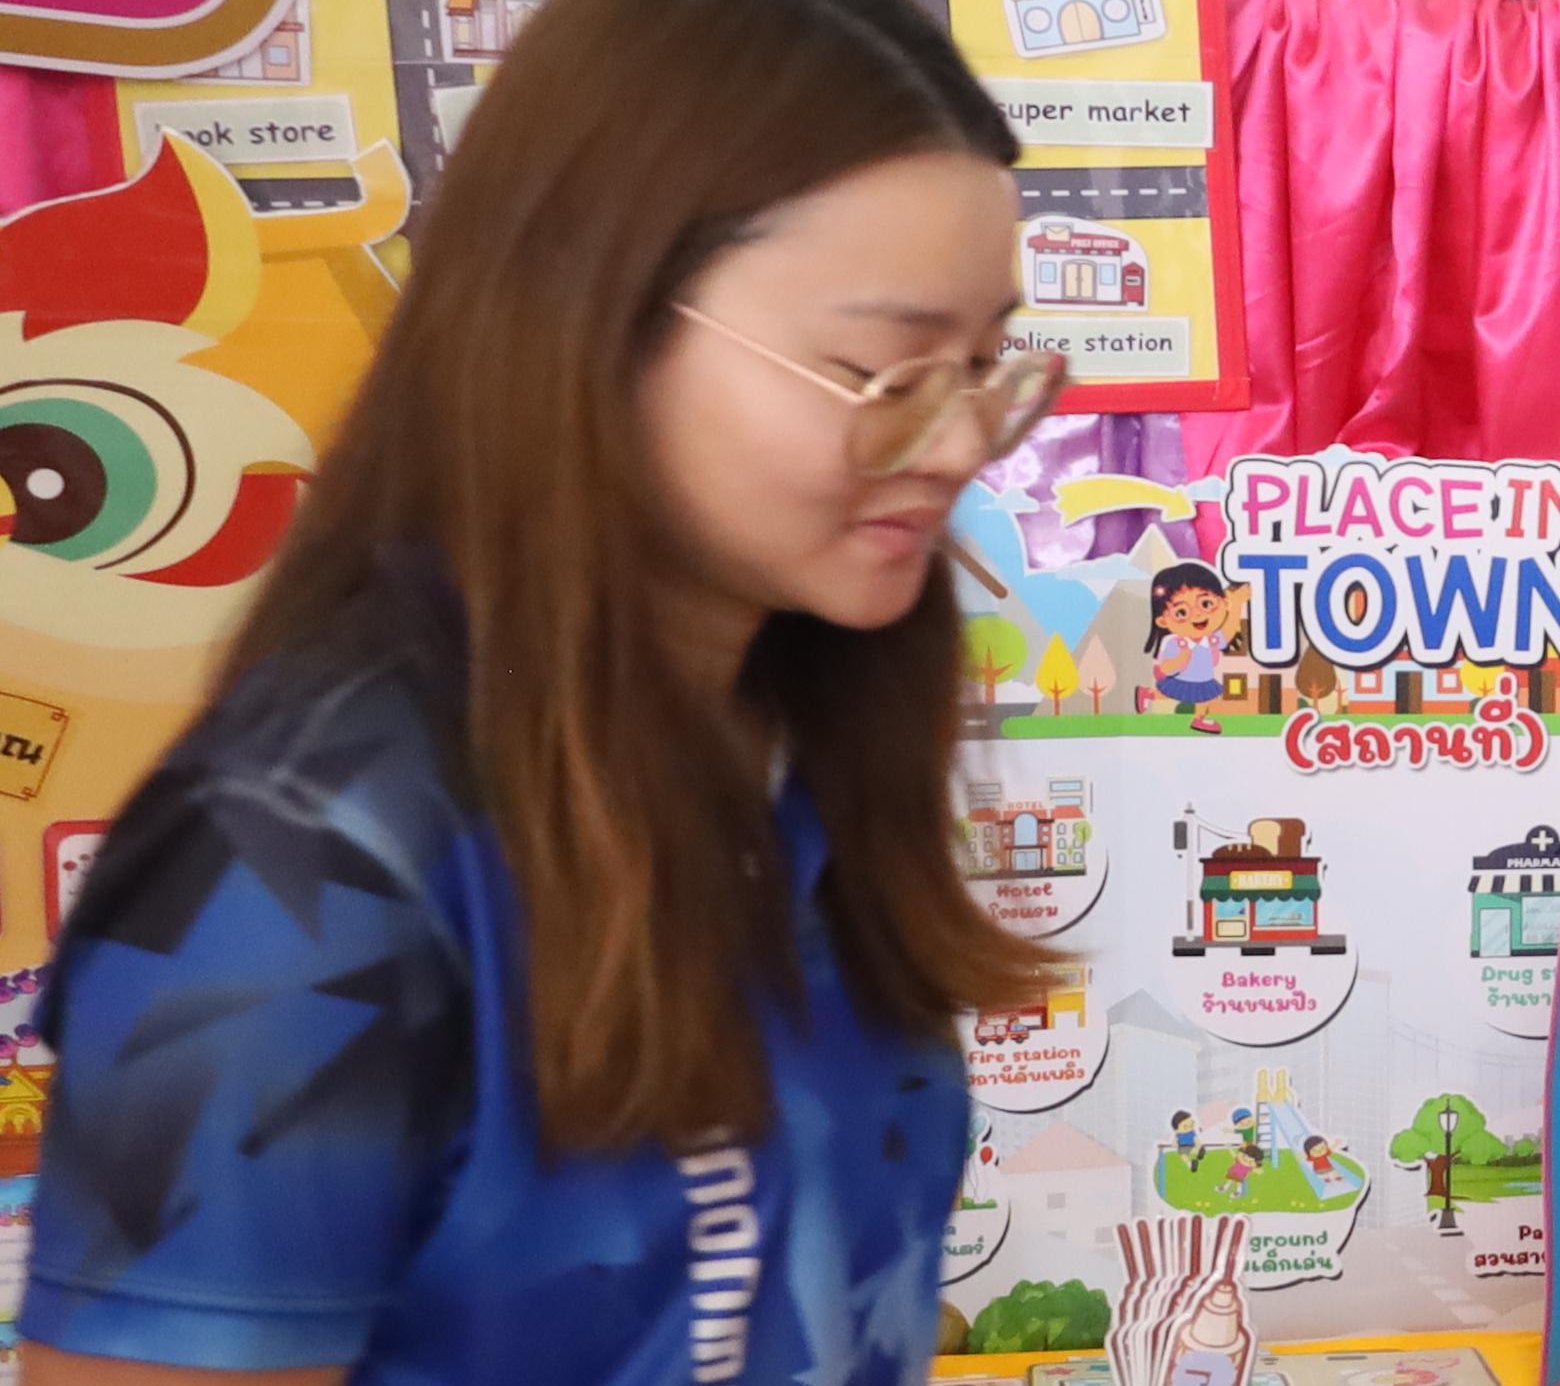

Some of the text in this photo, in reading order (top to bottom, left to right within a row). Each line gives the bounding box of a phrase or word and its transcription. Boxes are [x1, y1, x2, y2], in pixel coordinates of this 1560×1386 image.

[1088, 101, 1192, 124] market
[156, 120, 336, 146] ok store
[1084, 331, 1174, 353] station
[1242, 472, 1484, 540] PLACE
[1284, 675, 1546, 769] (สถานที่)
[996, 883, 1054, 899] Hotel
[1236, 874, 1284, 887] BAKERY
[1221, 972, 1297, 990] Bakery
[1480, 966, 1534, 985] Drug
[1202, 992, 1317, 1014] ร้านขนมปัง
[968, 1047, 1081, 1065] Fire station
